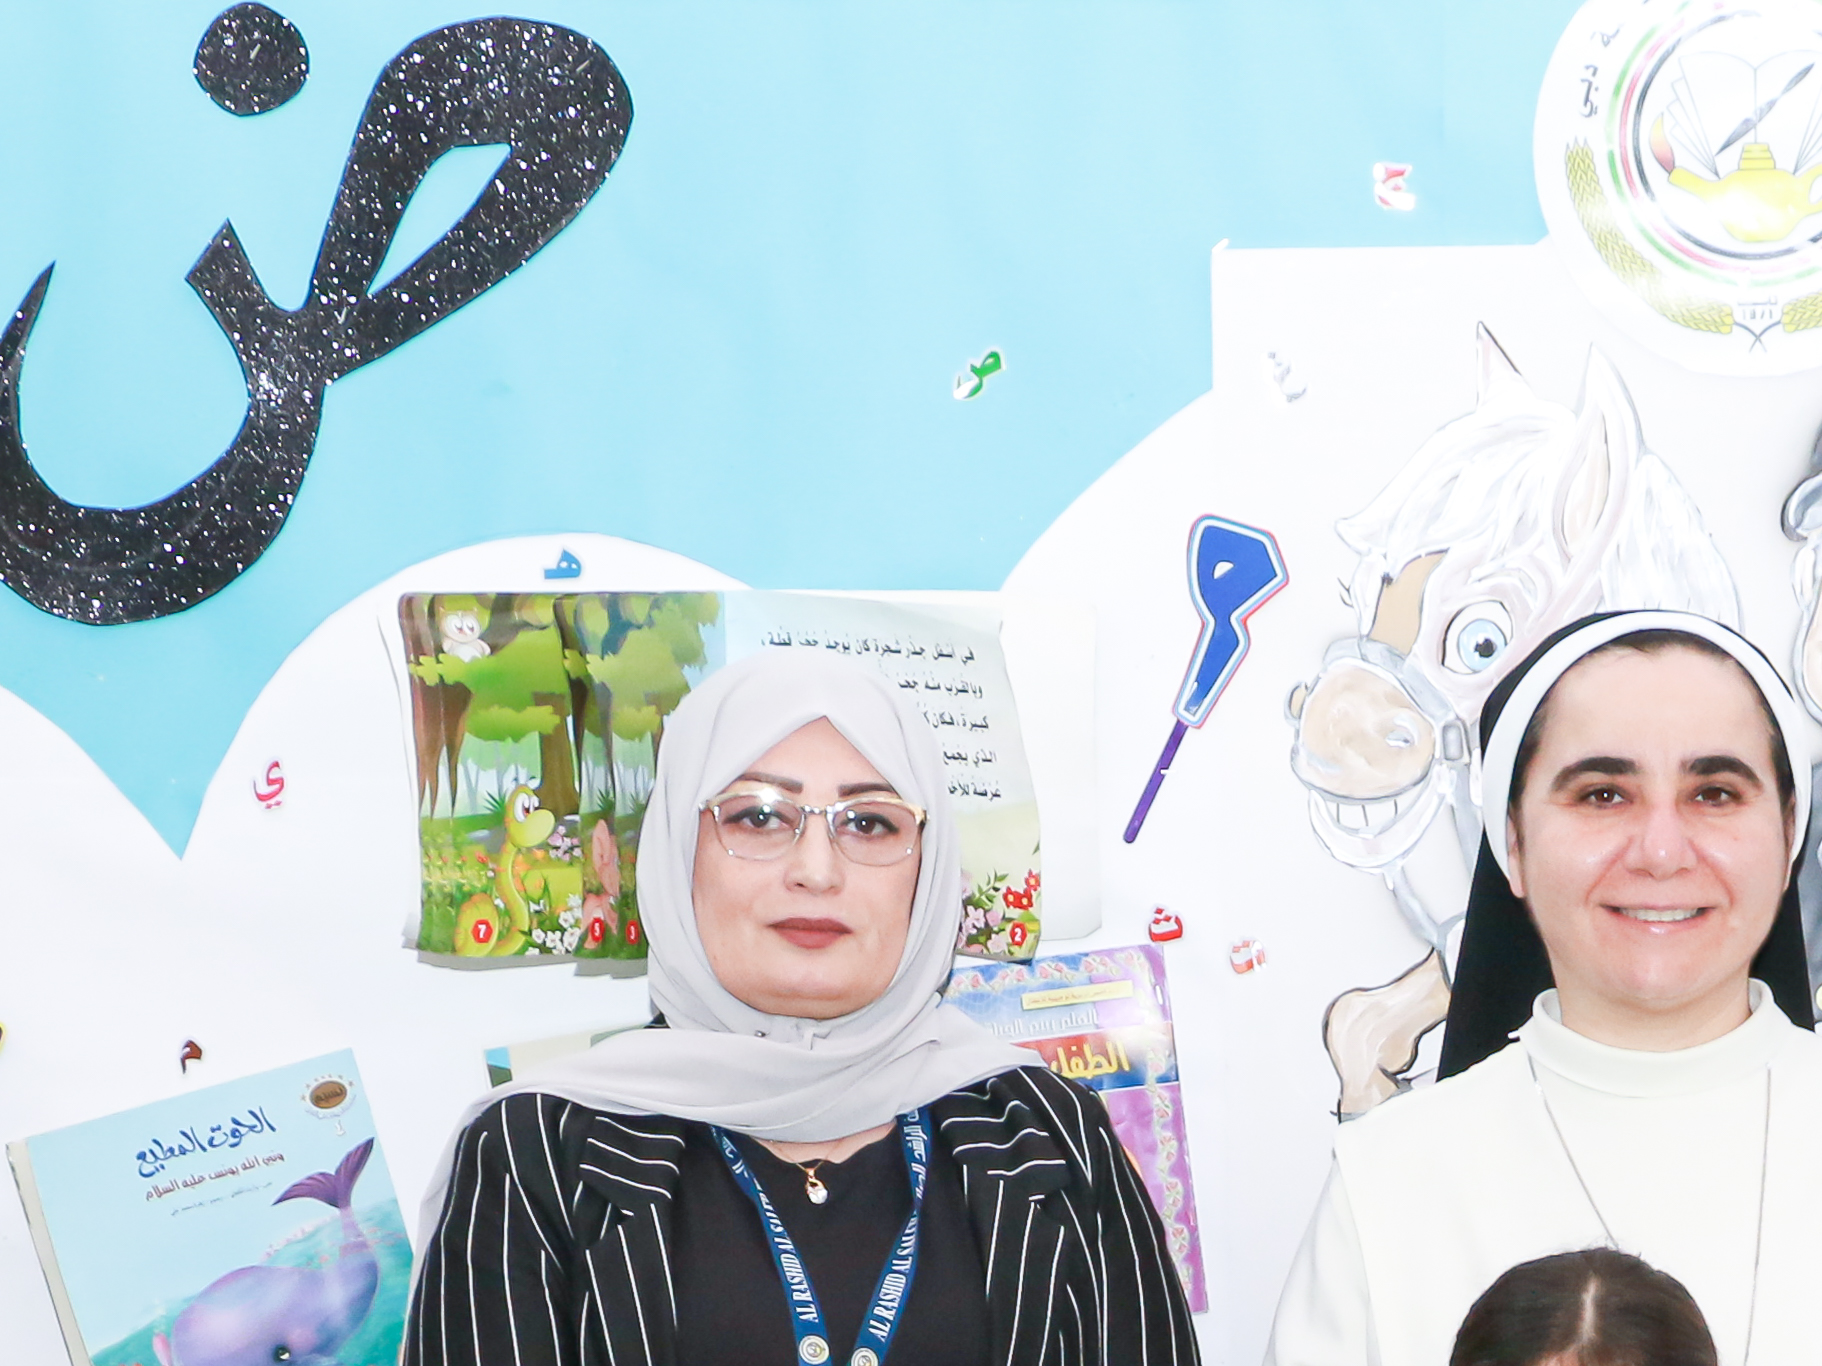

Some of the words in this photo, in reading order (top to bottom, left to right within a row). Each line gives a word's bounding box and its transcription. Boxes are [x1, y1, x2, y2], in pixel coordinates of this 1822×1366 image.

[0, 2, 634, 626] ض
[953, 350, 1003, 399] ص
[252, 757, 287, 810] ي
[477, 924, 487, 939] 7
[1014, 928, 1022, 941] 2
[1150, 907, 1183, 942] ث
[180, 1039, 203, 1075] م
[207, 1106, 277, 1149] الحوت
[136, 1126, 208, 1178] المطيع
[780, 1252, 815, 1304] RASHID
[891, 1255, 912, 1274] AL
[796, 1304, 819, 1323] AL
[874, 1272, 907, 1321] RASHID
[868, 1317, 892, 1343] AL
